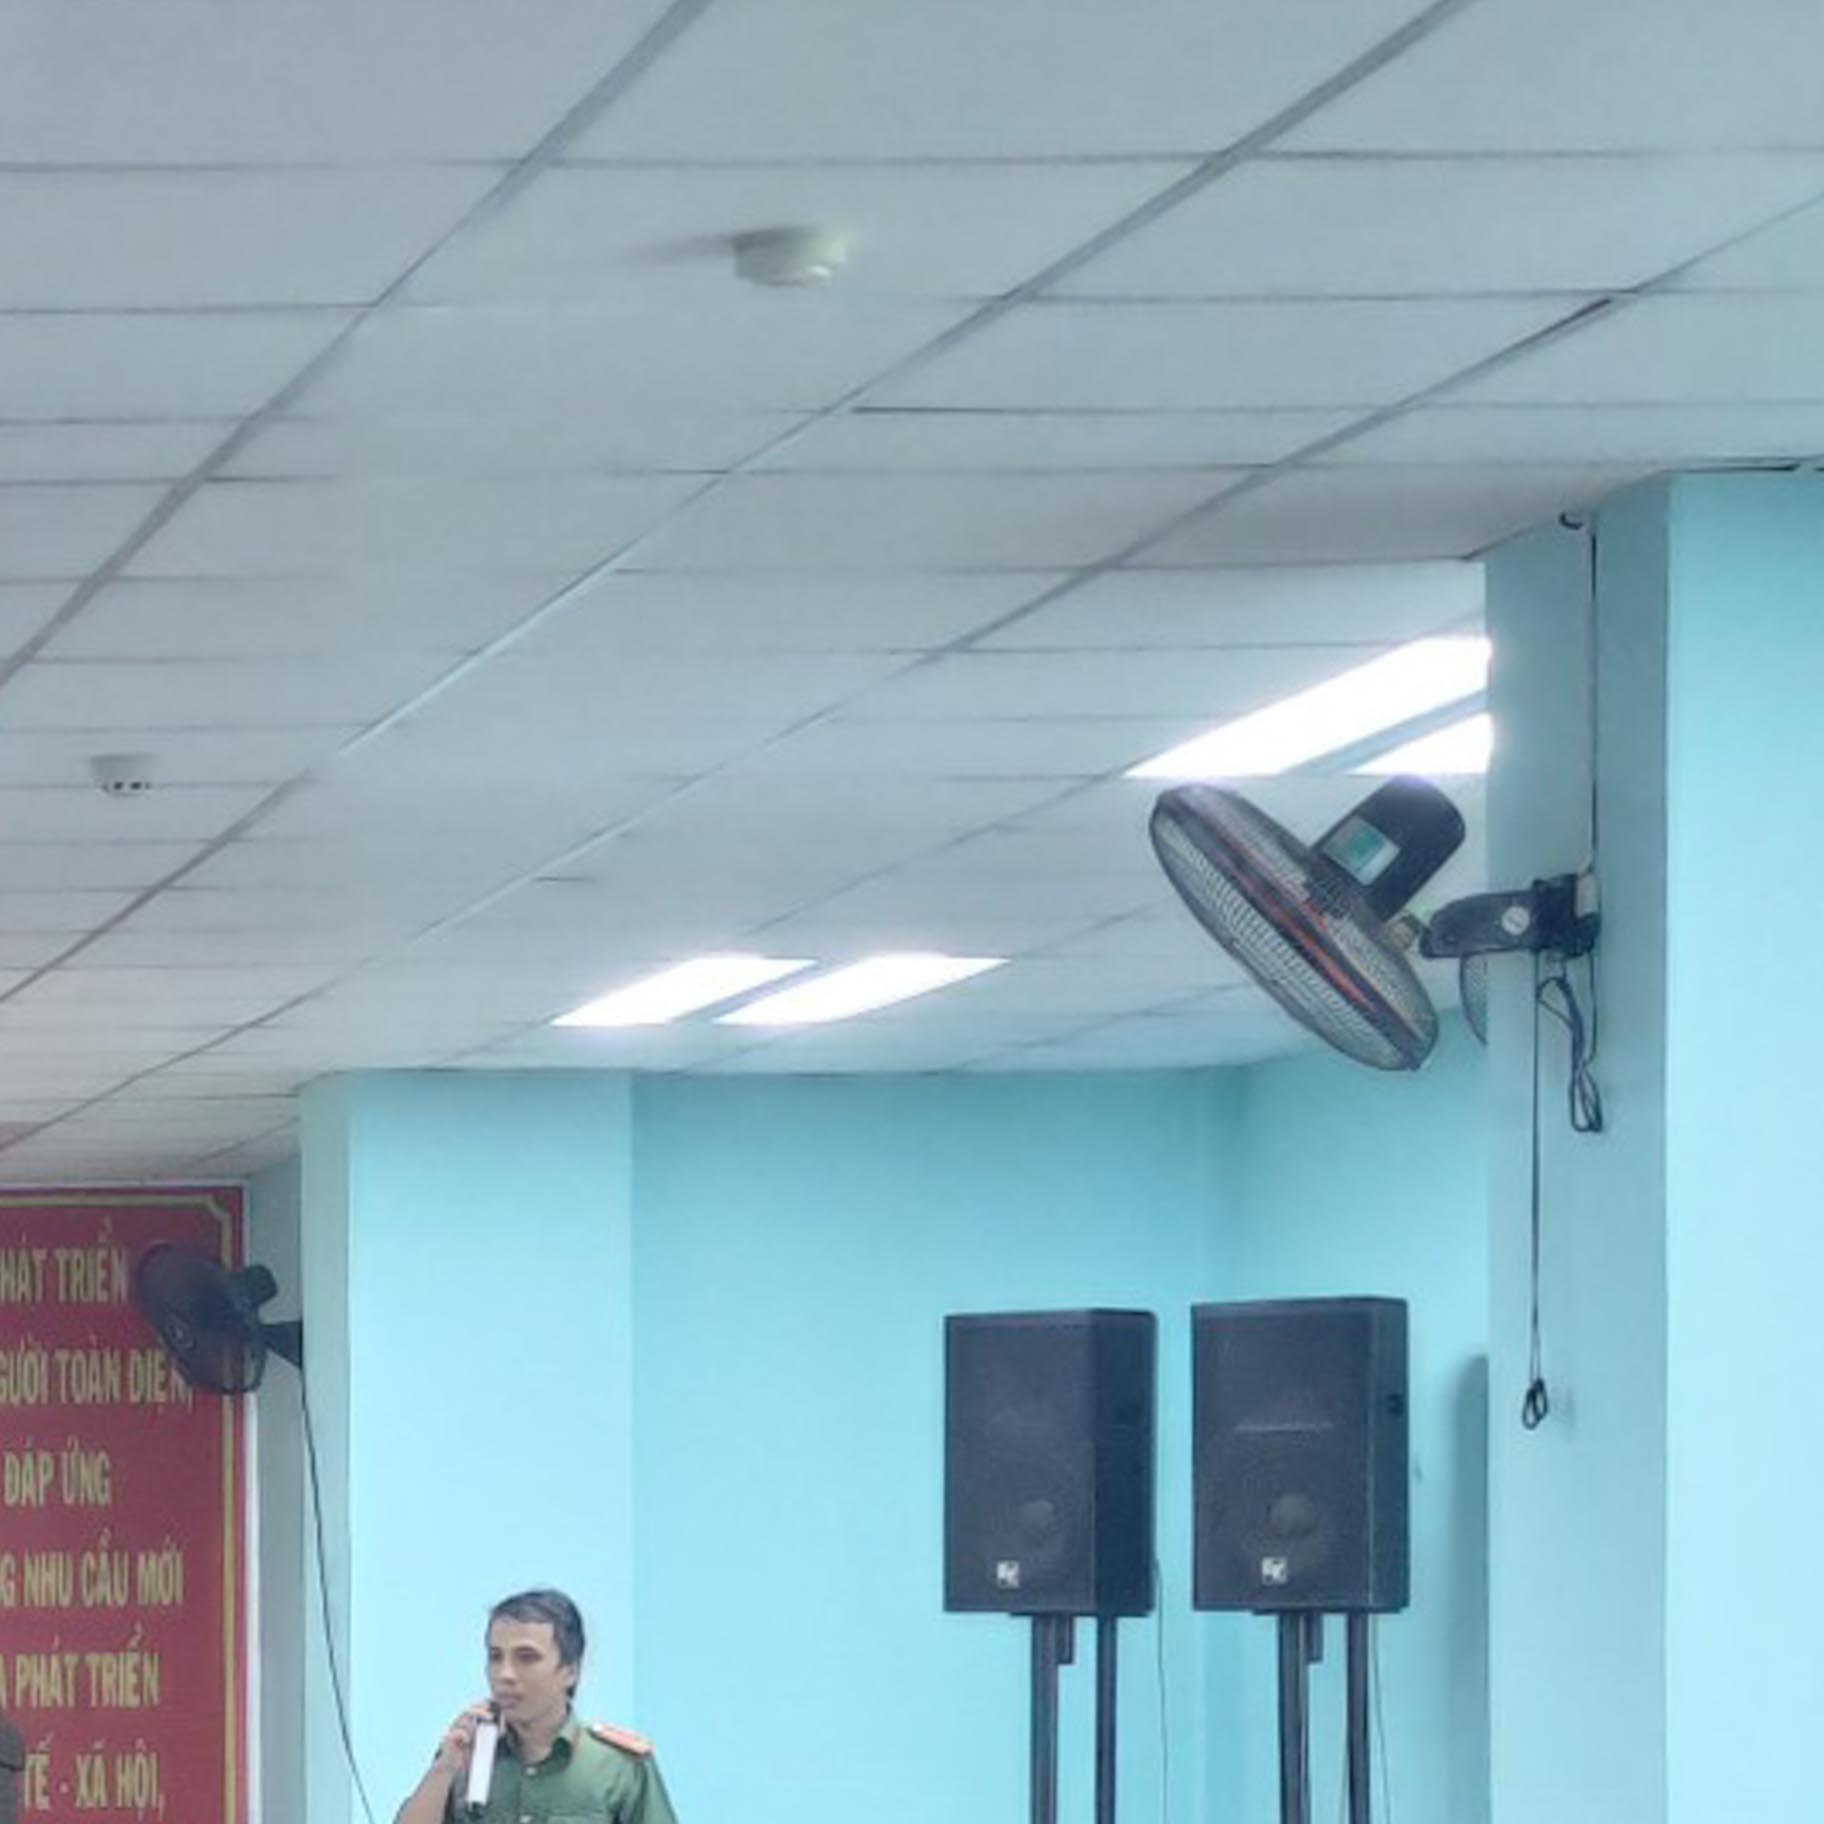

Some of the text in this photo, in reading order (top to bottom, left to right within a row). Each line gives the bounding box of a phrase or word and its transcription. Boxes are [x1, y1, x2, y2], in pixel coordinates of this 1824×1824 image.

[54, 1218, 129, 1303] TRIỂN
[54, 1335, 122, 1406] TOÀN
[3, 1435, 112, 1507] ĐÁP ỨNG
[23, 1551, 73, 1608] NHU
[80, 1529, 129, 1608] CẦU
[137, 1533, 184, 1608] MỚI
[15, 1635, 80, 1709] PHÁT
[86, 1624, 160, 1709] TRIỂN
[75, 1739, 108, 1810] XÃ
[116, 1738, 165, 1822] HỘI,
